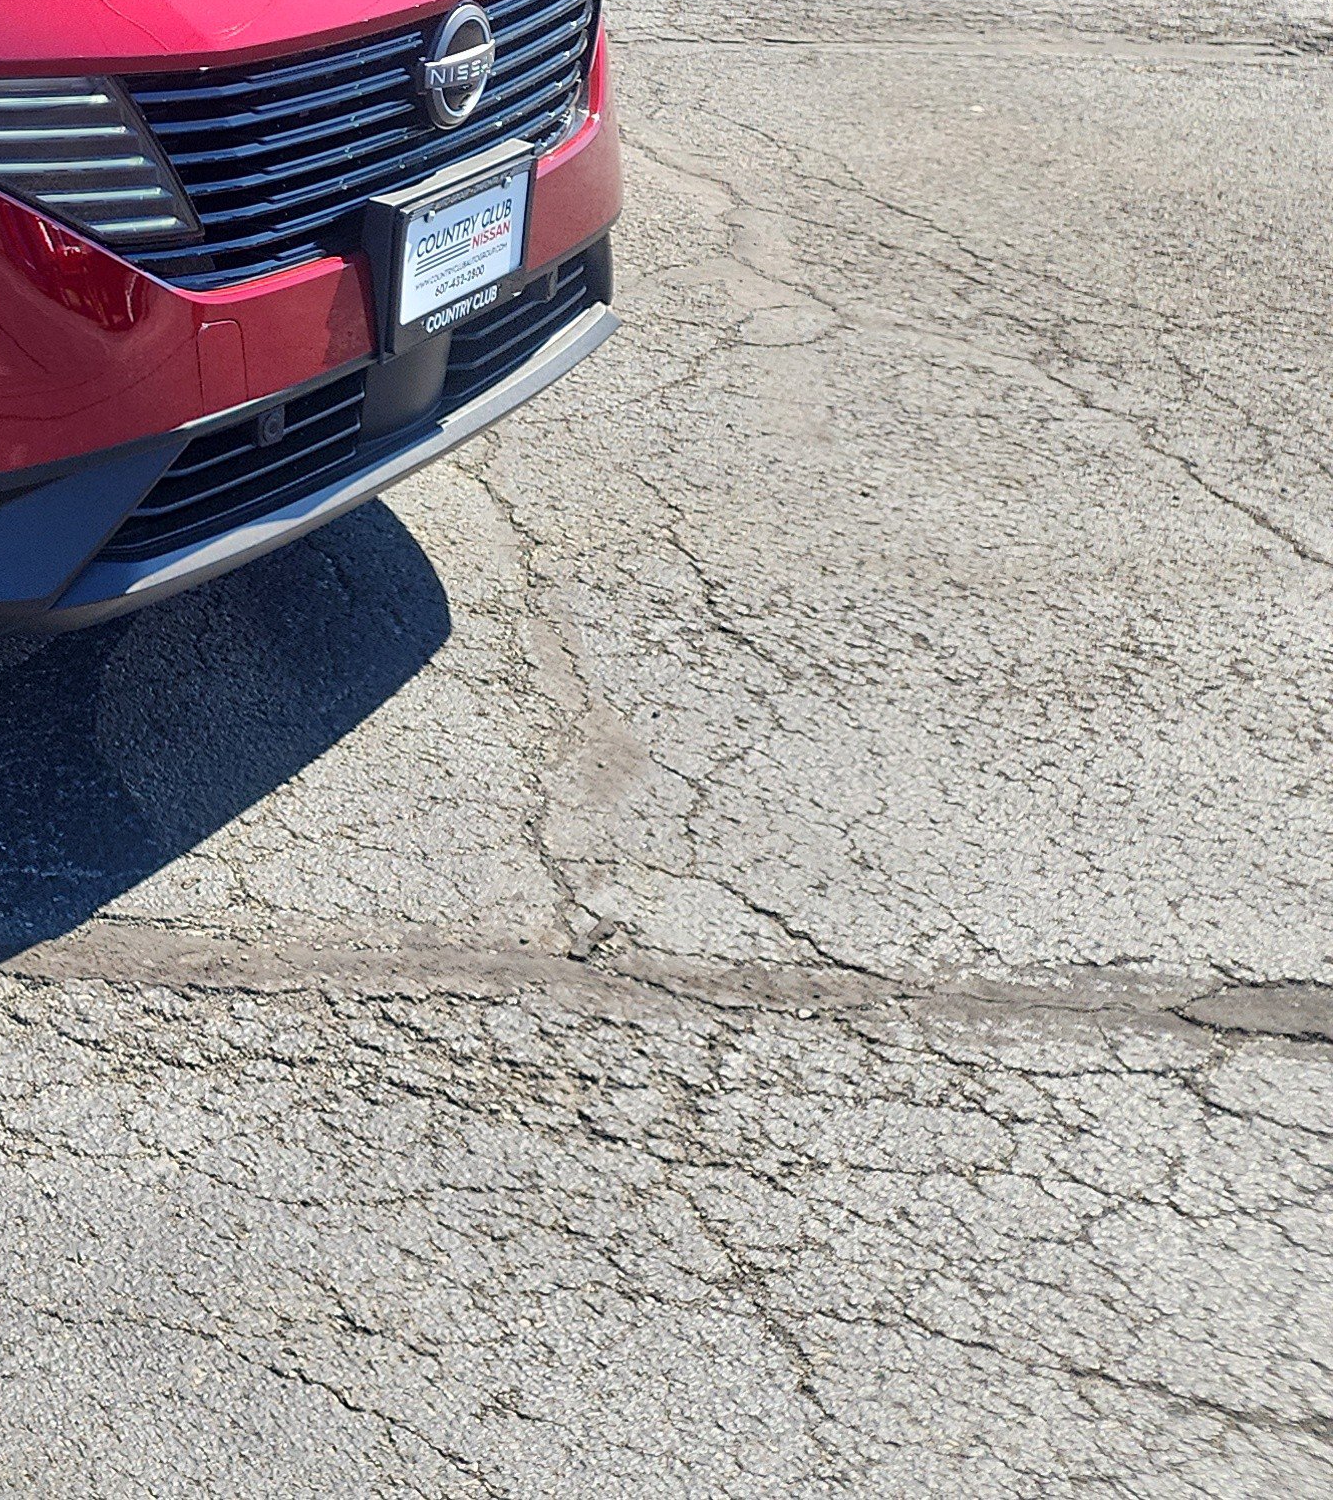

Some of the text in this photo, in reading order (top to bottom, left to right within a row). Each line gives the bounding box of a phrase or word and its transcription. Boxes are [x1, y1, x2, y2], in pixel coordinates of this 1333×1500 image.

[416, 198, 513, 258] COUNTRY CLUB
[472, 220, 511, 249] NISSAN
[426, 284, 498, 333] COUNTRY CLUB
